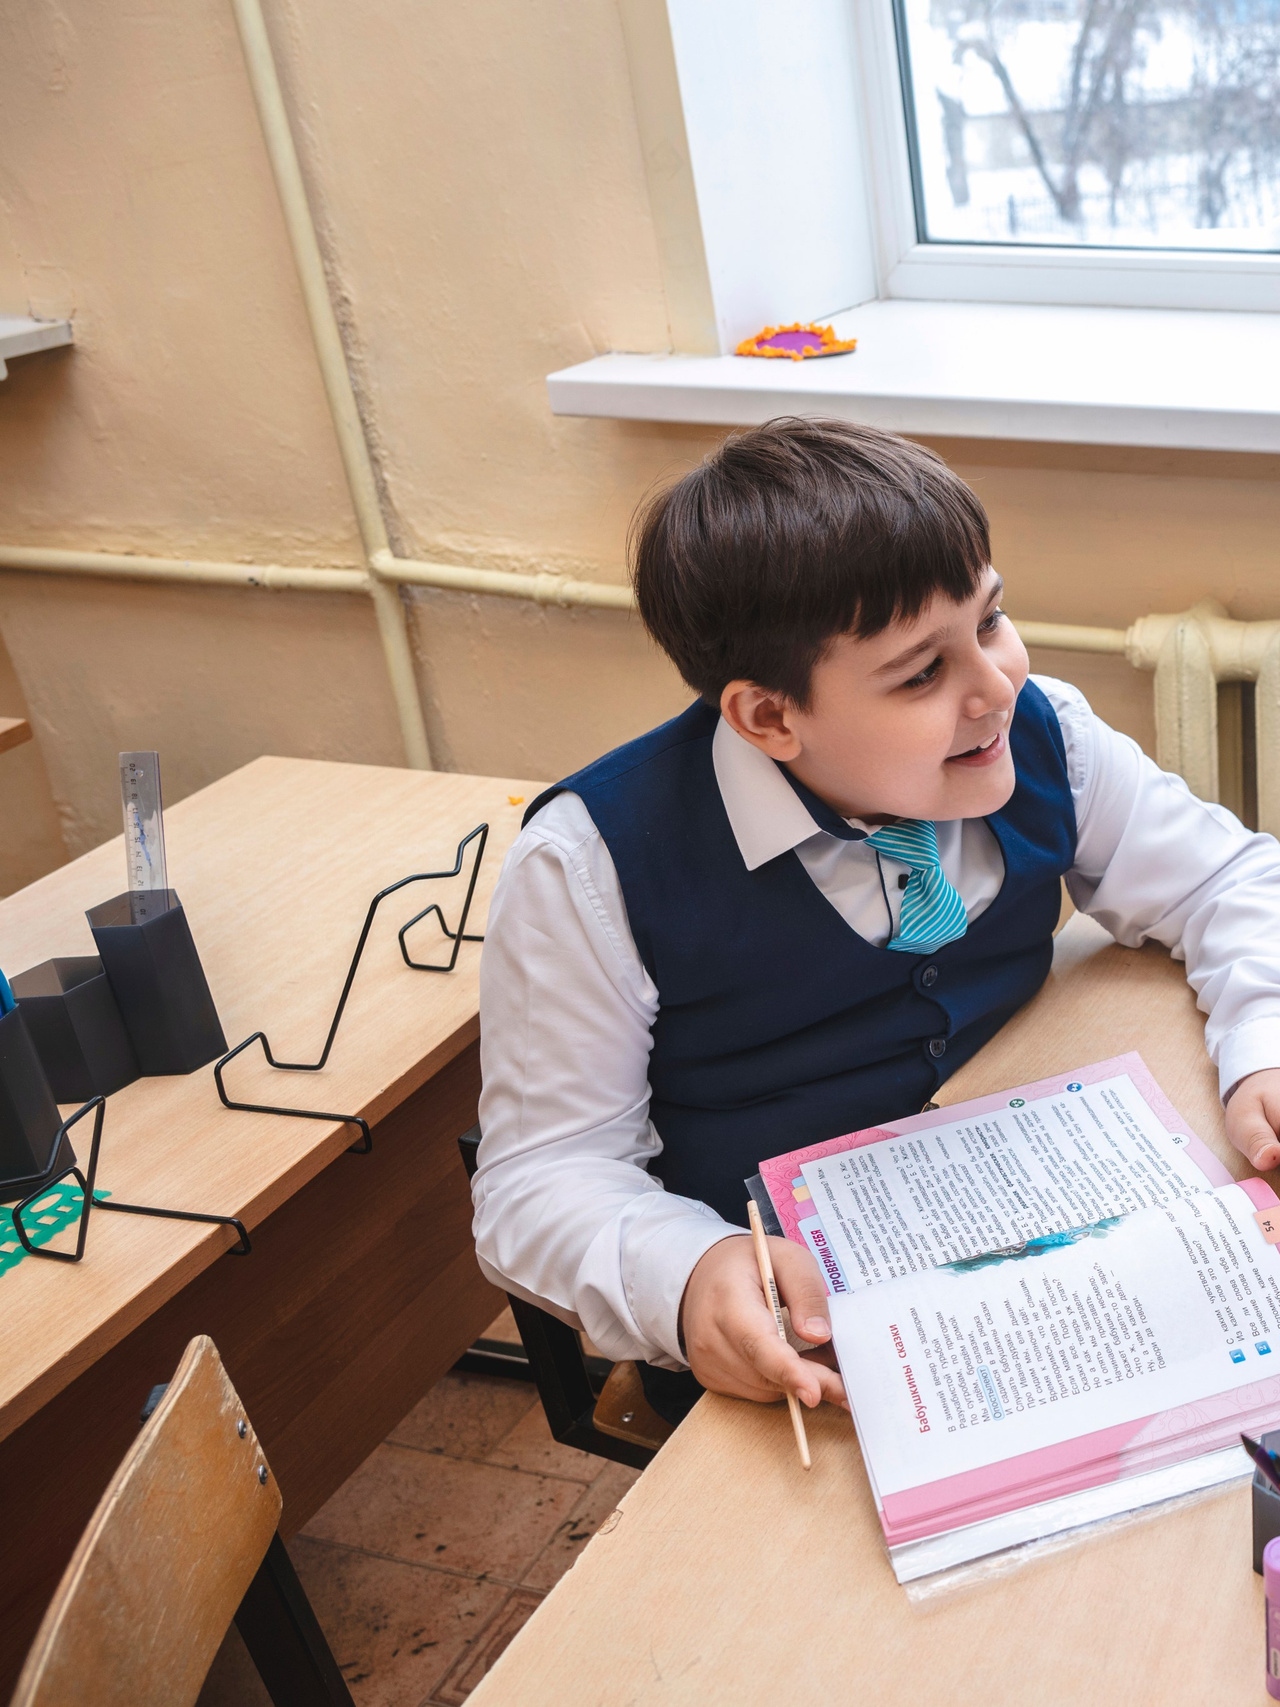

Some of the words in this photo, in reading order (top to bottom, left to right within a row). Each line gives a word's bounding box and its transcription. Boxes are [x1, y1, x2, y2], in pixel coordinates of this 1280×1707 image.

[1200, 1222, 1220, 1252] понятны?
[1262, 1220, 1275, 1233] 54
[811, 1230, 827, 1246] СЕБЯ
[1175, 1227, 1198, 1264] вспоминает
[1193, 1241, 1209, 1264] видно?
[1239, 1240, 1254, 1263] сказки
[819, 1247, 846, 1293] ПРОВЕРИМ
[873, 1268, 881, 1277] его
[899, 1265, 907, 1276] Как
[1094, 1263, 1108, 1285] зари?»
[1208, 1268, 1217, 1281] это
[1219, 1257, 1230, 1274] тебе
[1197, 1270, 1216, 1304] чувством
[1239, 1274, 1252, 1295] слова
[1253, 1268, 1266, 1289] какие
[1020, 1278, 1035, 1308] слышим,
[1053, 1279, 1068, 1301] спать?
[1089, 1276, 1106, 1309] несмело:
[1106, 1289, 1115, 1298] до
[1115, 1281, 1127, 1300] дело,
[1215, 1285, 1227, 1302] слов
[1230, 1279, 1243, 1301] слова
[981, 1301, 993, 1325] сказки
[1004, 1299, 1019, 1326] дышим.
[1019, 1307, 1030, 1325] идёт.
[1033, 1312, 1040, 1321] не
[1039, 1298, 1051, 1320] зовёт.
[1066, 1305, 1075, 1315] уж
[1072, 1291, 1091, 1331] загалдели,
[1087, 1295, 1106, 1338] приставать.
[1124, 1305, 1137, 1326] какое
[1133, 1296, 1147, 1324] говори.
[1225, 1306, 1238, 1327] каких
[1243, 1307, 1250, 1316] ли
[1250, 1300, 1270, 1333] значение
[910, 1308, 927, 1344] задворкам
[936, 1312, 954, 1350] пригоркам
[949, 1315, 964, 1340] домой.
[974, 1316, 987, 1337] рядка
[1038, 1326, 1046, 1338] что
[1059, 1319, 1071, 1339] Пора
[1104, 1313, 1121, 1345] бабушка
[1112, 1303, 1130, 1340] сидеть-то
[1215, 1310, 1229, 1332] каким
[1250, 1322, 1260, 1337] Все
[889, 1324, 906, 1358] сказки
[1016, 1331, 1025, 1344] еле
[1050, 1324, 1061, 1345] спать
[1072, 1319, 1085, 1346] теперь
[1089, 1335, 1098, 1347] мы
[1135, 1331, 1145, 1346] нам
[1146, 1328, 1155, 1337] да
[1236, 1331, 1245, 1341] Из
[924, 1349, 932, 1358] по
[932, 1339, 948, 1369] гурьбой
[968, 1331, 983, 1364] салазки,
[983, 1341, 994, 1355] два
[991, 1329, 1010, 1373] бабушкины
[1023, 1349, 1032, 1363] мы,
[1027, 1330, 1043, 1362] полночи
[1069, 1344, 1079, 1359] все.
[1083, 1350, 1092, 1363] как
[1130, 1344, 1136, 1353] ж,
[1152, 1342, 1166, 1369] Говори
[951, 1355, 959, 1364] по
[960, 1345, 974, 1375] бредём
[1005, 1332, 1028, 1388] Ивана-дурака.
[1045, 1343, 1069, 1398] Притворимся,
[1059, 1350, 1071, 1371] мама
[1097, 1352, 1108, 1374] опять
[1104, 1343, 1123, 1382] Начинаем
[1119, 1351, 1134, 1378] Скажет
[1134, 1357, 1143, 1374] «Что
[929, 1363, 941, 1386] вечер
[1029, 1368, 1043, 1393] сидим
[1069, 1376, 1080, 1395] Если
[1077, 1364, 1091, 1391] Сказки
[1094, 1377, 1102, 1388] Но
[957, 1369, 974, 1409] сугробам,
[973, 1380, 984, 1403] идём,
[978, 1368, 1003, 1419] Опостылеют
[993, 1370, 1009, 1403] садимся
[1009, 1377, 1024, 1412] Слушать
[1044, 1376, 1058, 1402] Время
[903, 1365, 931, 1433] Бабушкины
[937, 1391, 952, 1421] зимний
[944, 1374, 967, 1429] Разухабистой
[1026, 1392, 1035, 1408] Про
[971, 1414, 979, 1425] По
[982, 1408, 990, 1422] Мы
